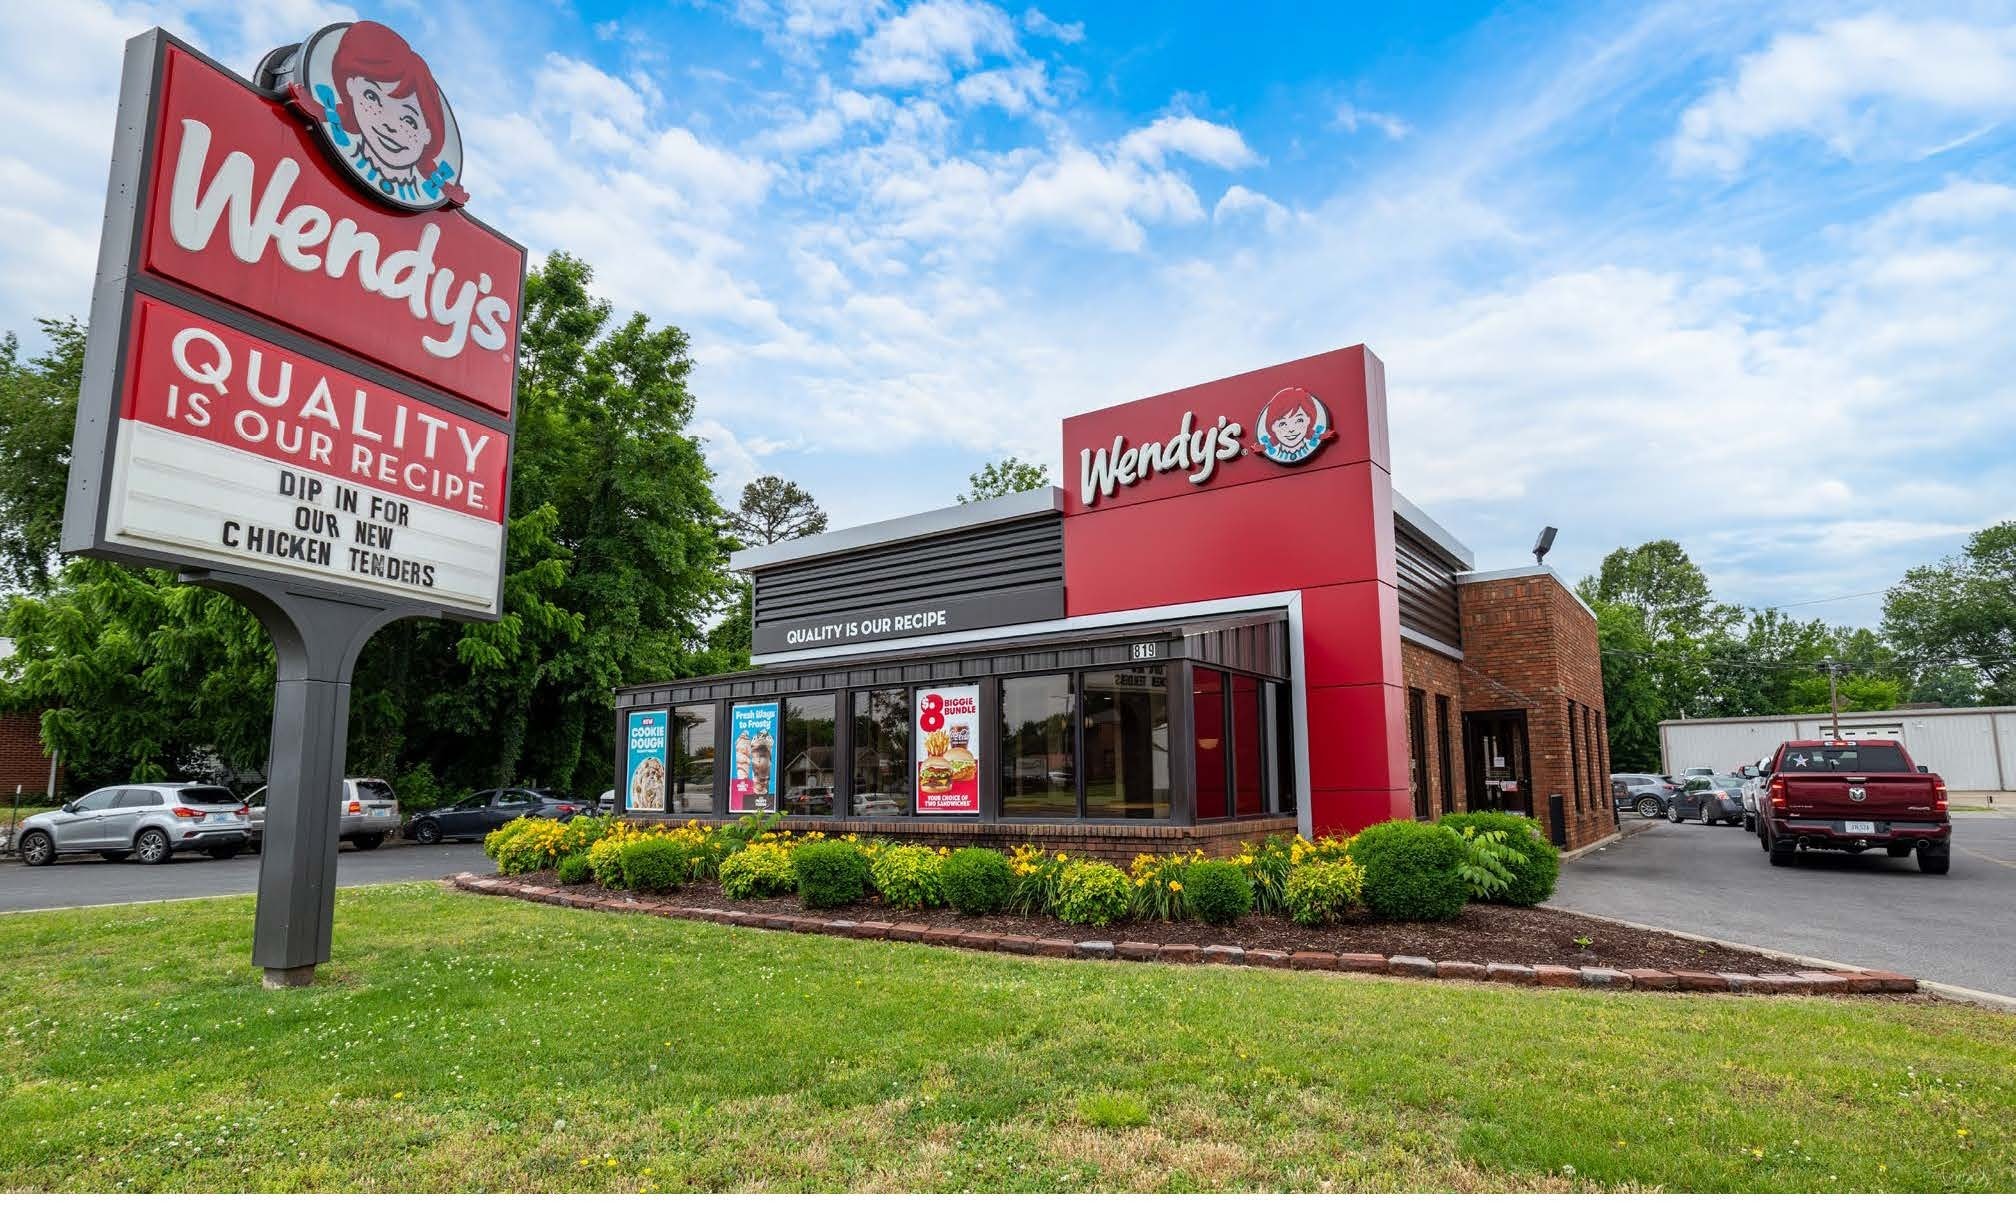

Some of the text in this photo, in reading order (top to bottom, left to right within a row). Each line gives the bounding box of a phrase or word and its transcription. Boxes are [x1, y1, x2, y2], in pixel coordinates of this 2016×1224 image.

[170, 118, 511, 359] Wendy's
[171, 327, 490, 473] QUALITY
[166, 384, 211, 427] IS
[234, 409, 333, 466] OUR
[1080, 411, 1242, 506] Wendy's
[279, 470, 409, 527] DIP IN FOR
[294, 506, 393, 550] OUR NEW
[222, 520, 435, 587] CHICKEN TENDERS
[786, 610, 947, 644] QUALITY IS OUR RECIPE
[1134, 643, 1155, 658] 819
[735, 711, 755, 720] Fresh
[944, 698, 973, 706] BIGGIE
[944, 706, 976, 715] BUNDLE
[631, 727, 665, 737] COOKIE
[739, 720, 771, 730] to Frosty
[631, 737, 664, 749] DOUGH
